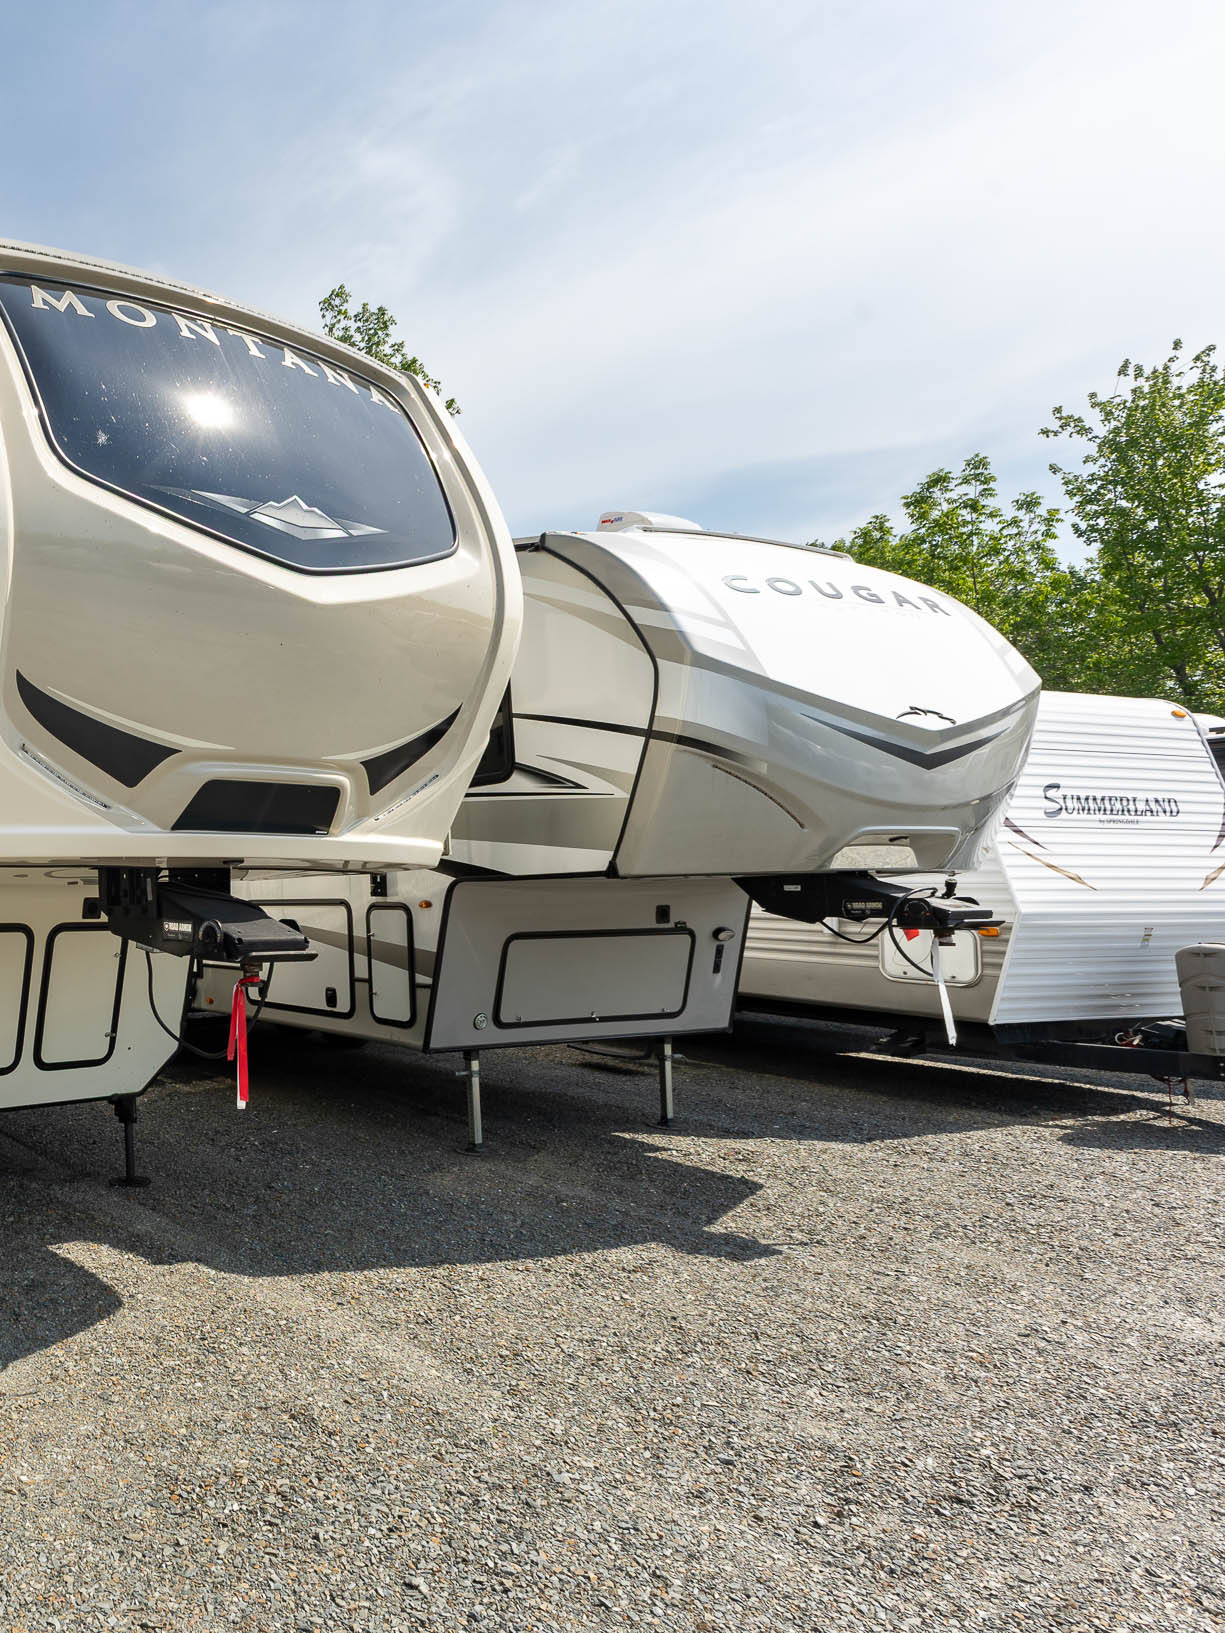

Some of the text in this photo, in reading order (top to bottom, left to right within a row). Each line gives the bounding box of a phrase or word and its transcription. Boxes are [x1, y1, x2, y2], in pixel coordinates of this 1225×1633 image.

[30, 284, 402, 415] MONTANA
[722, 575, 952, 616] COUGAR
[1042, 782, 1181, 819] SUMMERLAND
